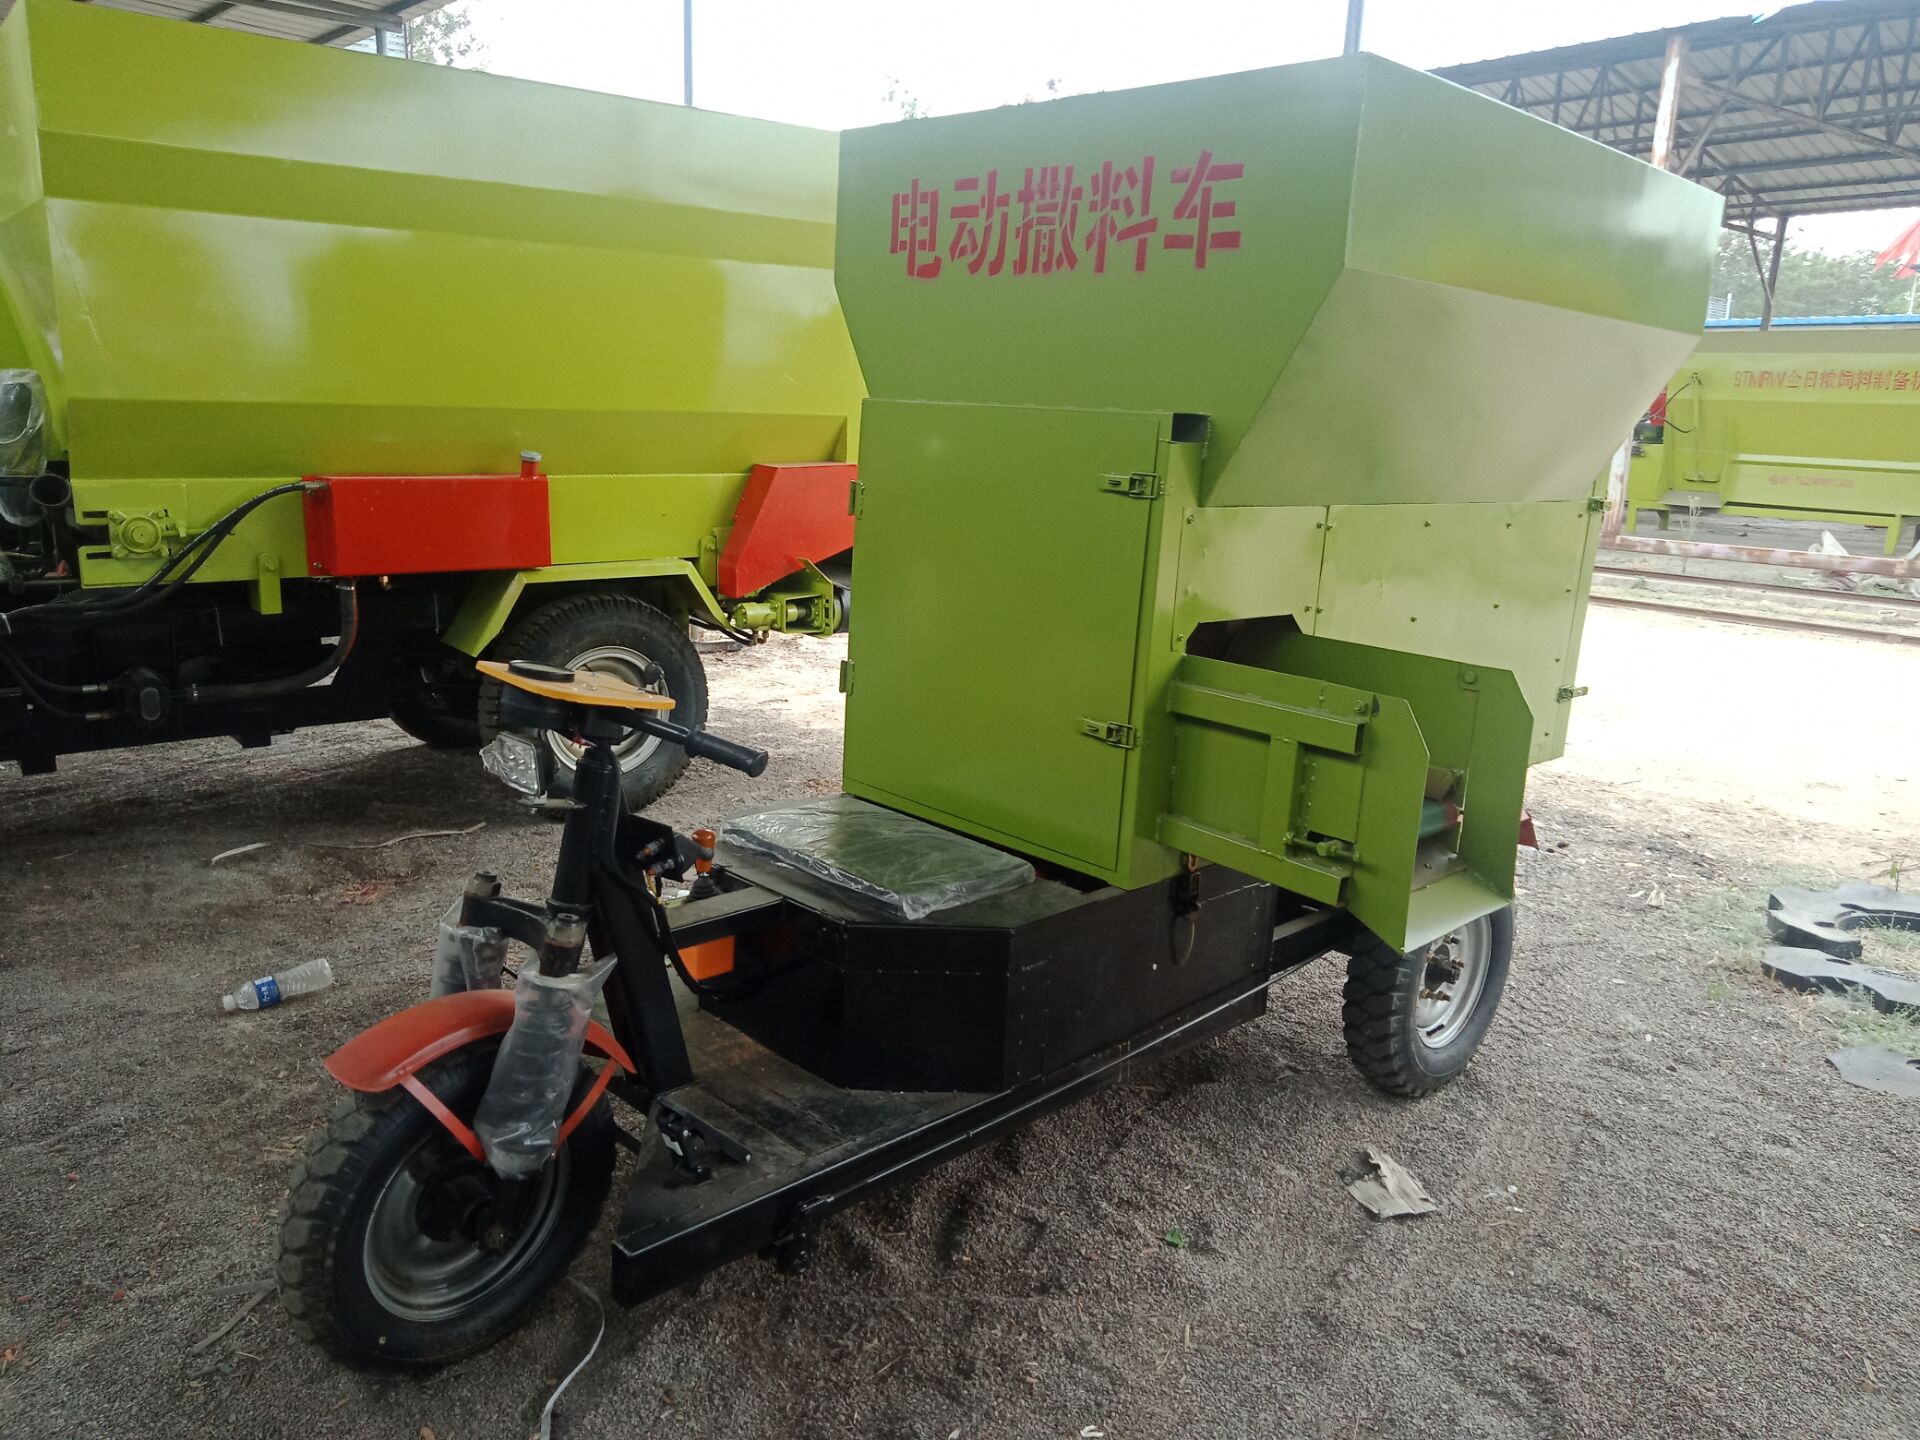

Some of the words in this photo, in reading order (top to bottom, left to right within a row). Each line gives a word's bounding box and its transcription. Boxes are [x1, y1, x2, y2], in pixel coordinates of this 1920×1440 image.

[890, 150, 1244, 279] 电动撒料车
